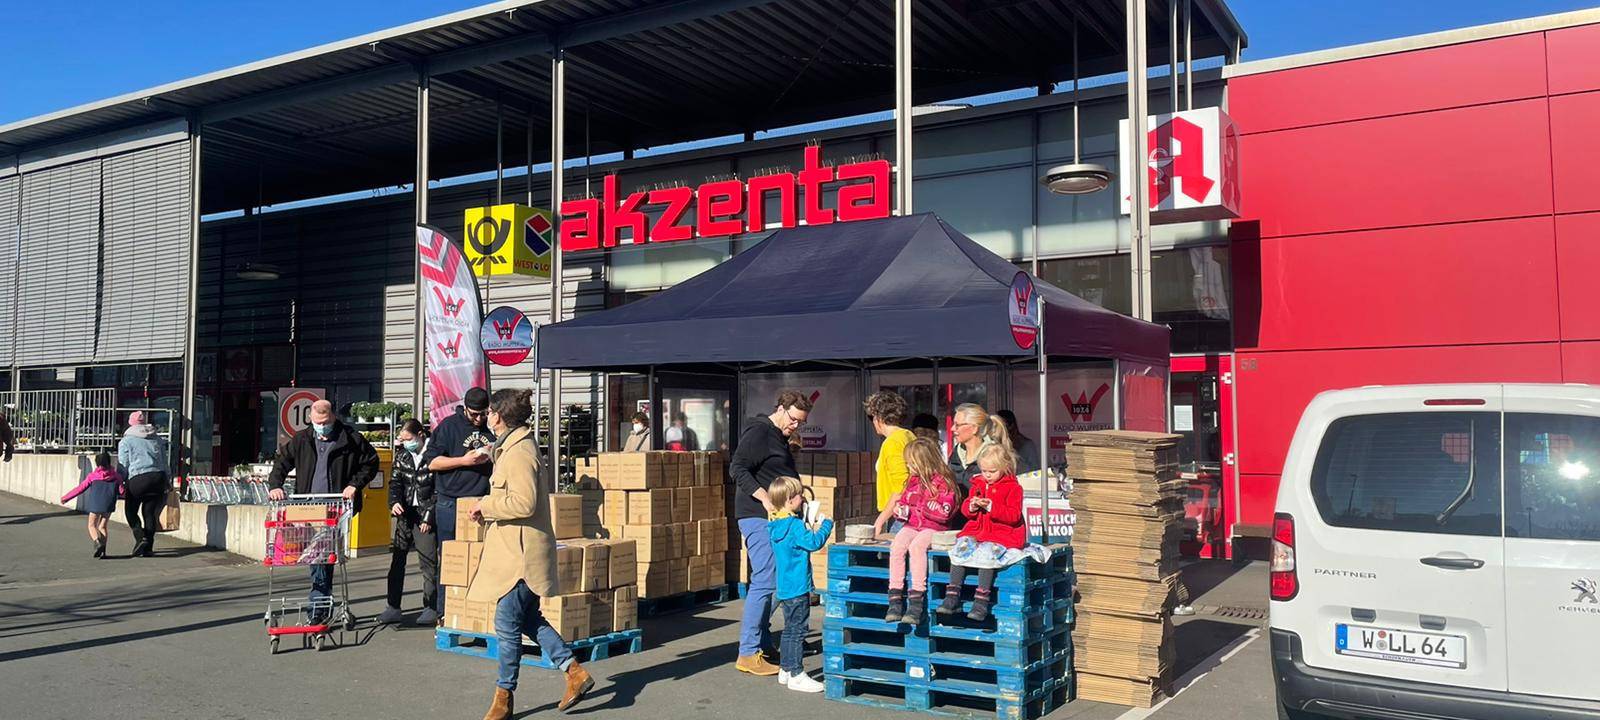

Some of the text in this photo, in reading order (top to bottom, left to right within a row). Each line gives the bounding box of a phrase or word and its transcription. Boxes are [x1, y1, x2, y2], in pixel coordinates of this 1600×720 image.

[560, 145, 890, 251] akzenta
[514, 259, 533, 269] WEST
[293, 405, 312, 426] 10
[1077, 422, 1114, 432] WUPPERTA
[1029, 514, 1077, 525] HEZLICH
[1314, 568, 1377, 579] PARTNER
[1362, 630, 1448, 657] W LL 64
